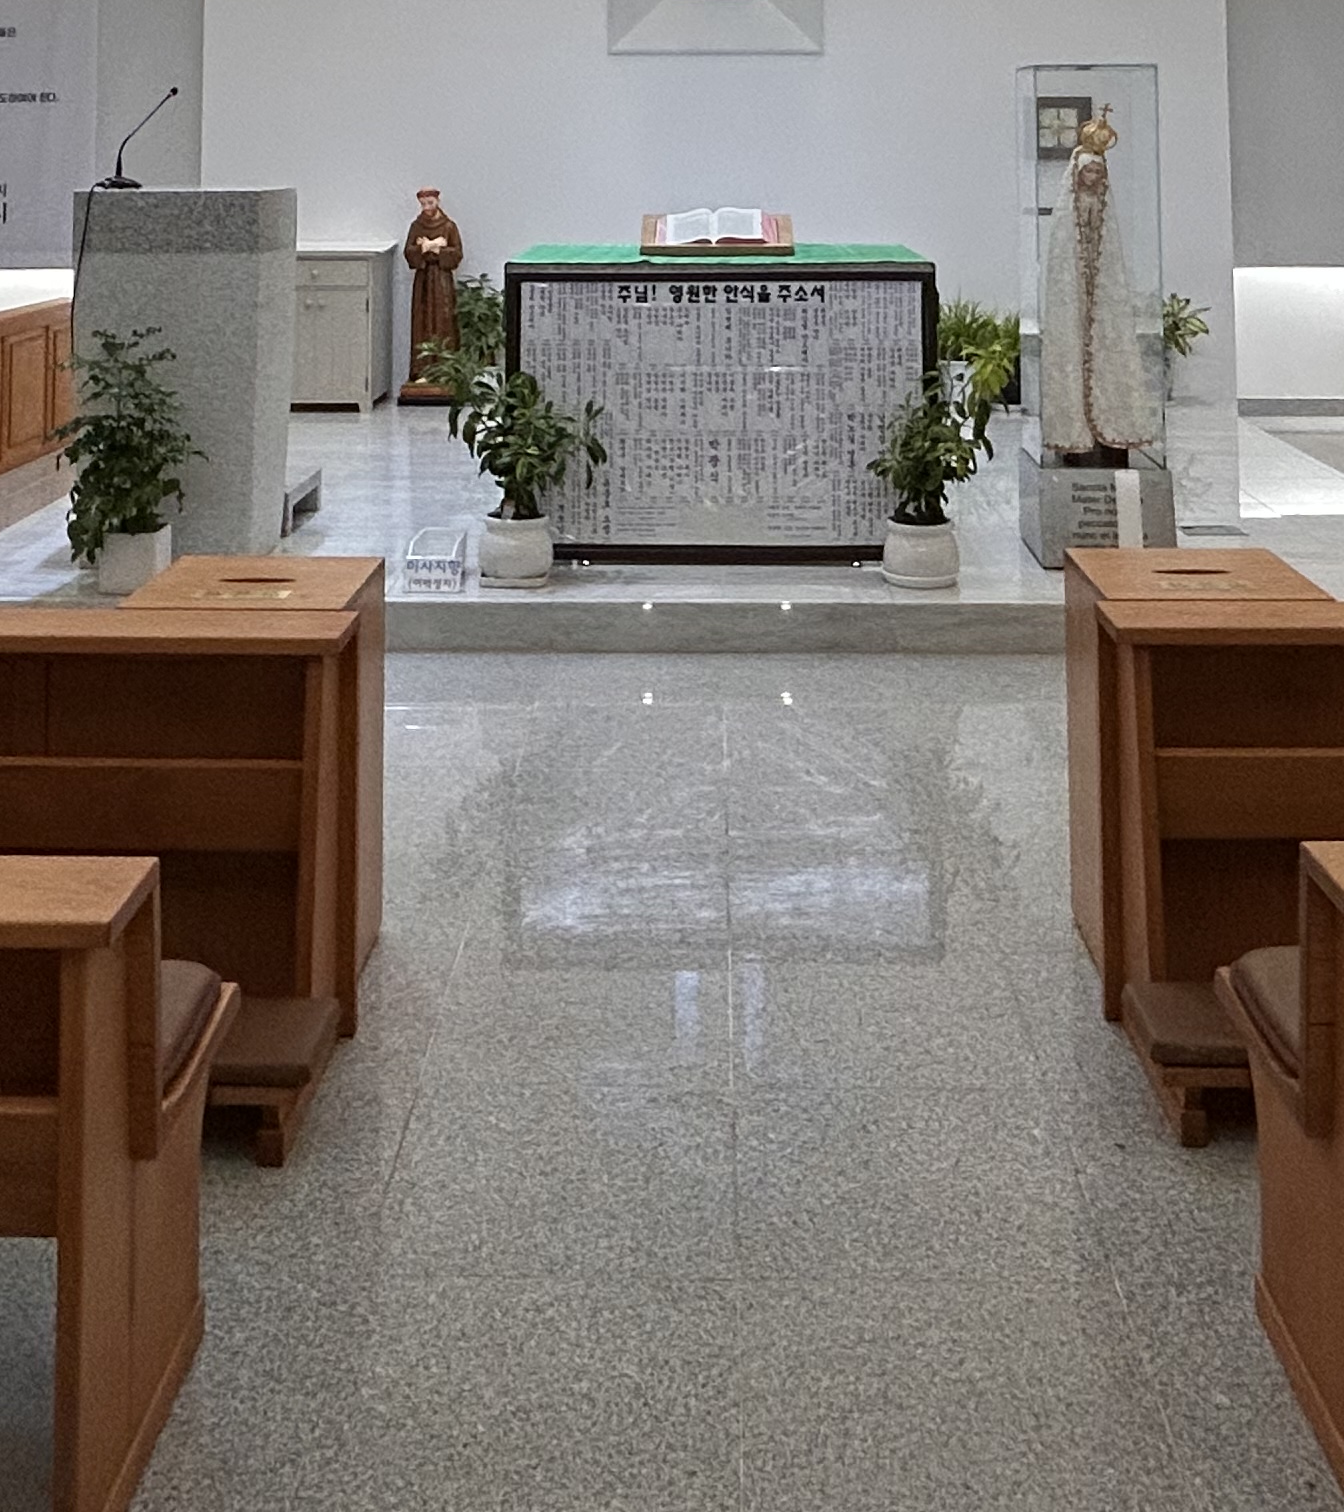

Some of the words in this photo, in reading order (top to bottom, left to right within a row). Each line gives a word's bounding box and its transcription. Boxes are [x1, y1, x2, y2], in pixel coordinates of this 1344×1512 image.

[617, 284, 657, 304] 주님!
[722, 284, 772, 304] 안식을
[776, 284, 826, 304] 주소서
